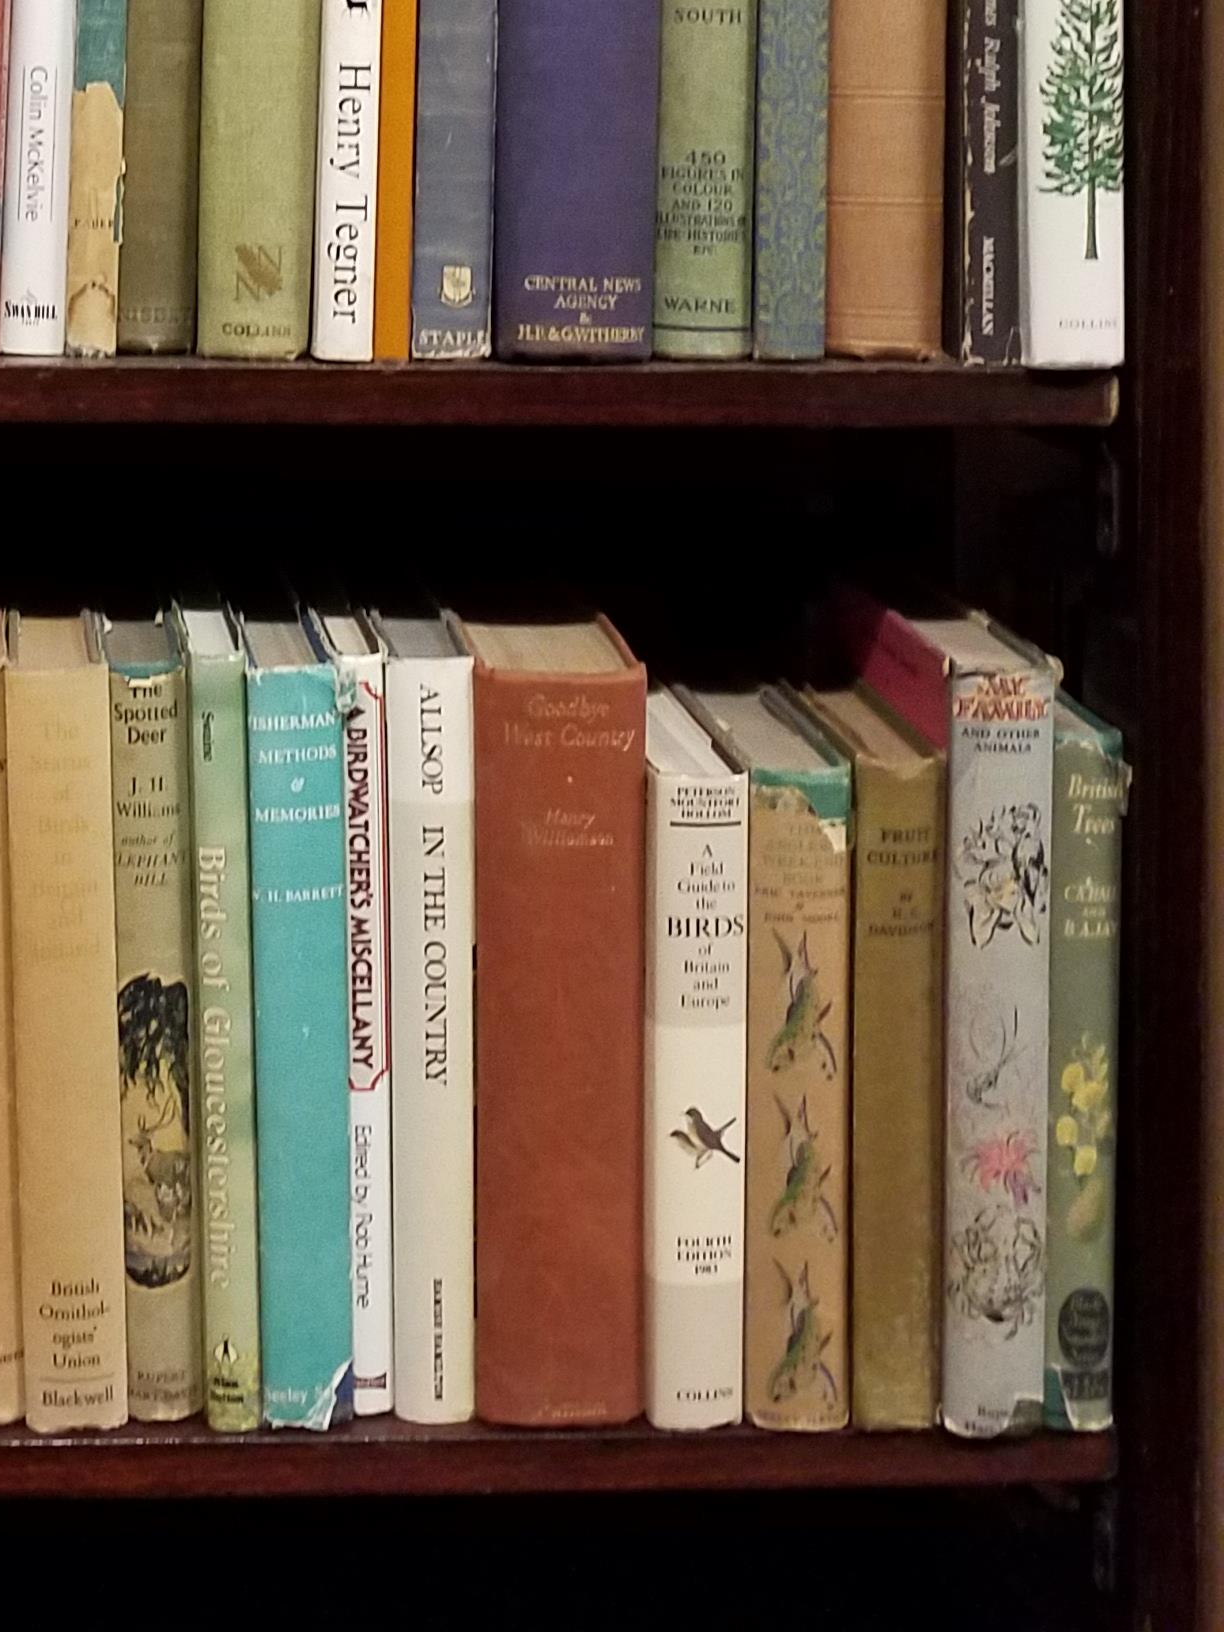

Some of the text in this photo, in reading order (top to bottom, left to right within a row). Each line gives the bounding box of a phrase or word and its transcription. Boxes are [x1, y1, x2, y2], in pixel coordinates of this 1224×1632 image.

[675, 8, 742, 24] SOUTH
[330, 63, 371, 180] Henry
[325, 195, 369, 325] Tegner
[524, 275, 641, 292] CENTRAL NEWS
[554, 295, 618, 310] AGENCY
[664, 297, 735, 314] WARNE
[113, 701, 178, 723] Spotted
[127, 727, 167, 745] Deer
[258, 743, 337, 764] METHODS
[255, 804, 341, 823] MEMORIES
[419, 682, 449, 1087] ALLSOP IN THE COUNTRY
[346, 726, 374, 1071] BIRDWATCHER'S MISCELLANY
[668, 918, 744, 938] BIRDS
[684, 961, 730, 974] Britain
[694, 978, 718, 990] and
[198, 845, 241, 1289] Birds of Gloucestershire
[50, 1278, 100, 1297] British
[52, 1352, 101, 1370] Union
[42, 1386, 115, 1408] Blackwell
